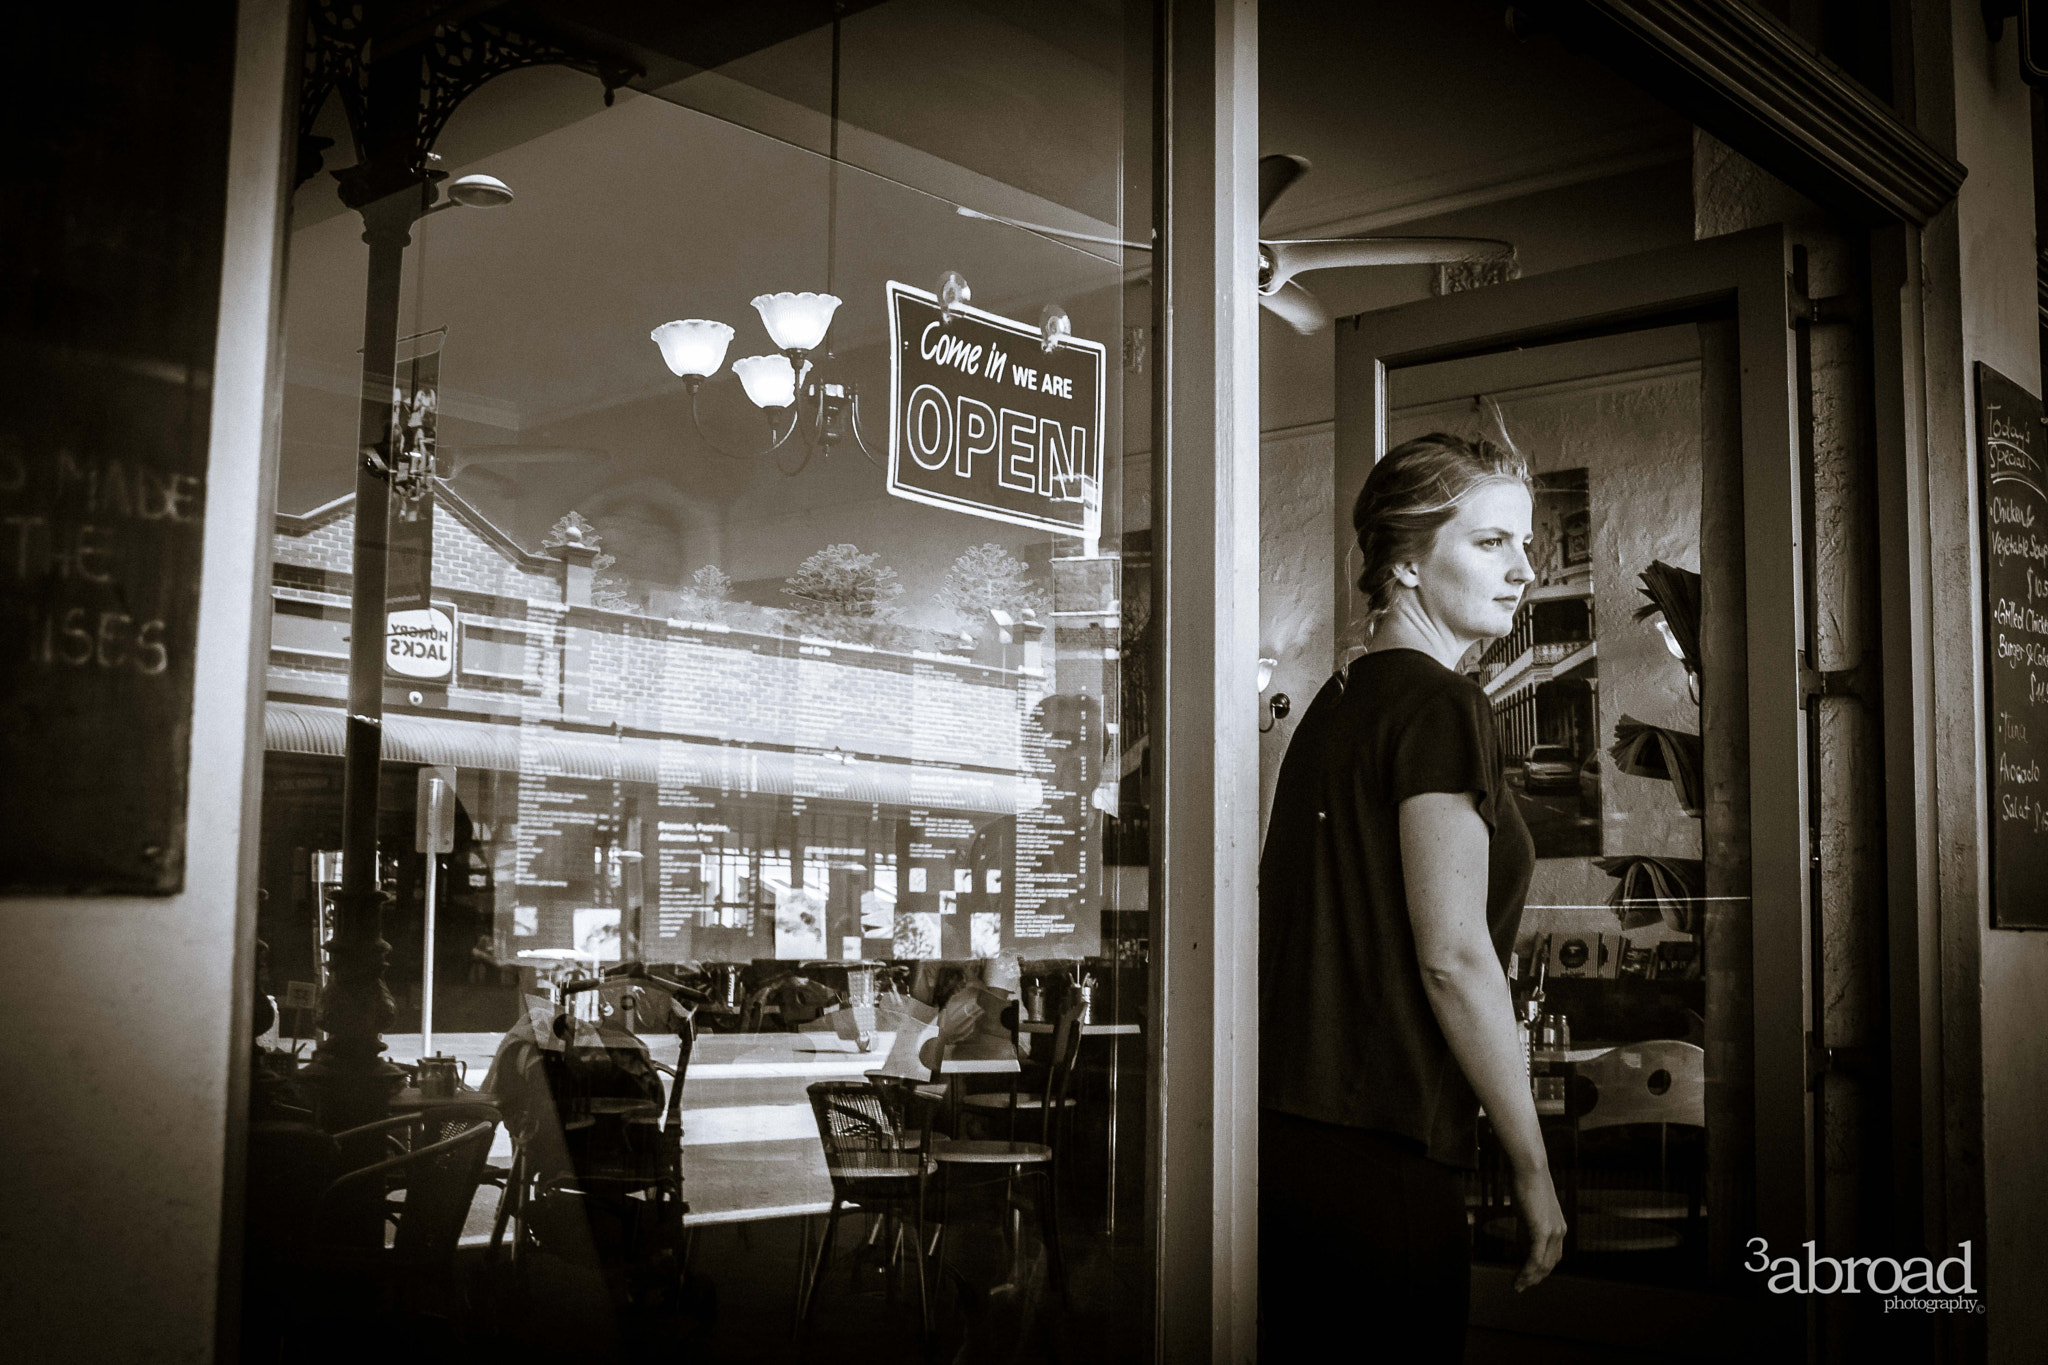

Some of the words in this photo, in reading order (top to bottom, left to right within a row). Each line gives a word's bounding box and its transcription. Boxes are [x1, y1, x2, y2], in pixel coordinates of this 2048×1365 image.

[920, 320, 983, 376] Come
[984, 341, 1007, 384] in
[1012, 363, 1038, 392] WE
[1040, 372, 1073, 400] ARE
[906, 383, 1086, 503] OPEN
[3, 516, 116, 582] THE
[38, 607, 168, 676] ISES
[2001, 711, 2028, 744] Tuna
